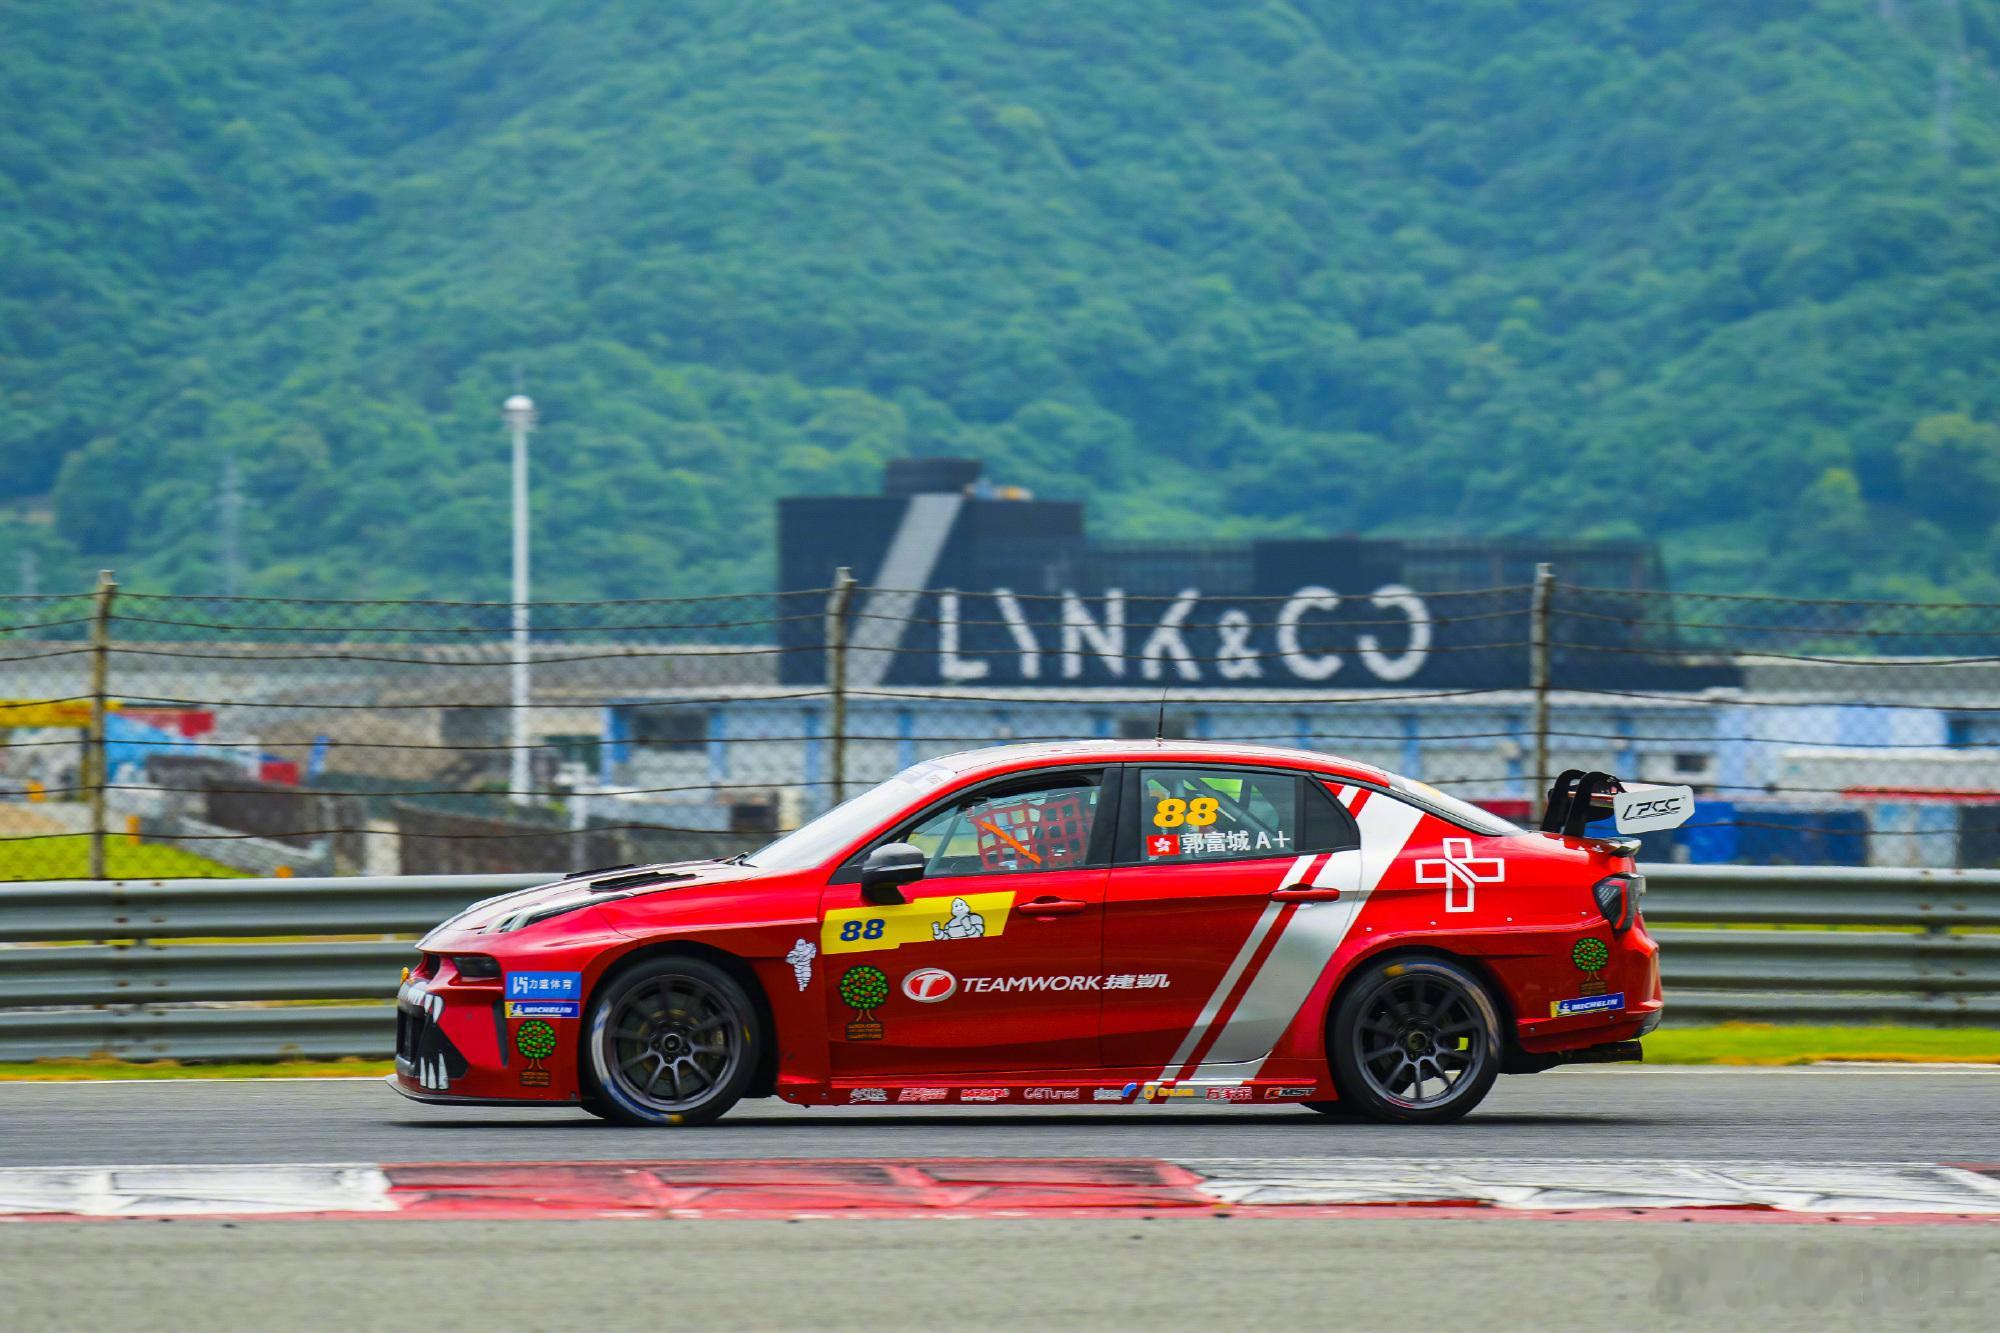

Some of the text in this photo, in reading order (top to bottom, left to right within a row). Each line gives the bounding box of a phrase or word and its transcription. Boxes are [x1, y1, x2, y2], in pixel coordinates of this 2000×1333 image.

[1153, 797, 1219, 828] 88
[1180, 830, 1291, 854] 郭富城 A+
[840, 918, 885, 942] 88
[961, 975, 1103, 993] TEAMWORK
[524, 1006, 573, 1014] MICHELIN
[1571, 998, 1619, 1011] MICHELIN
